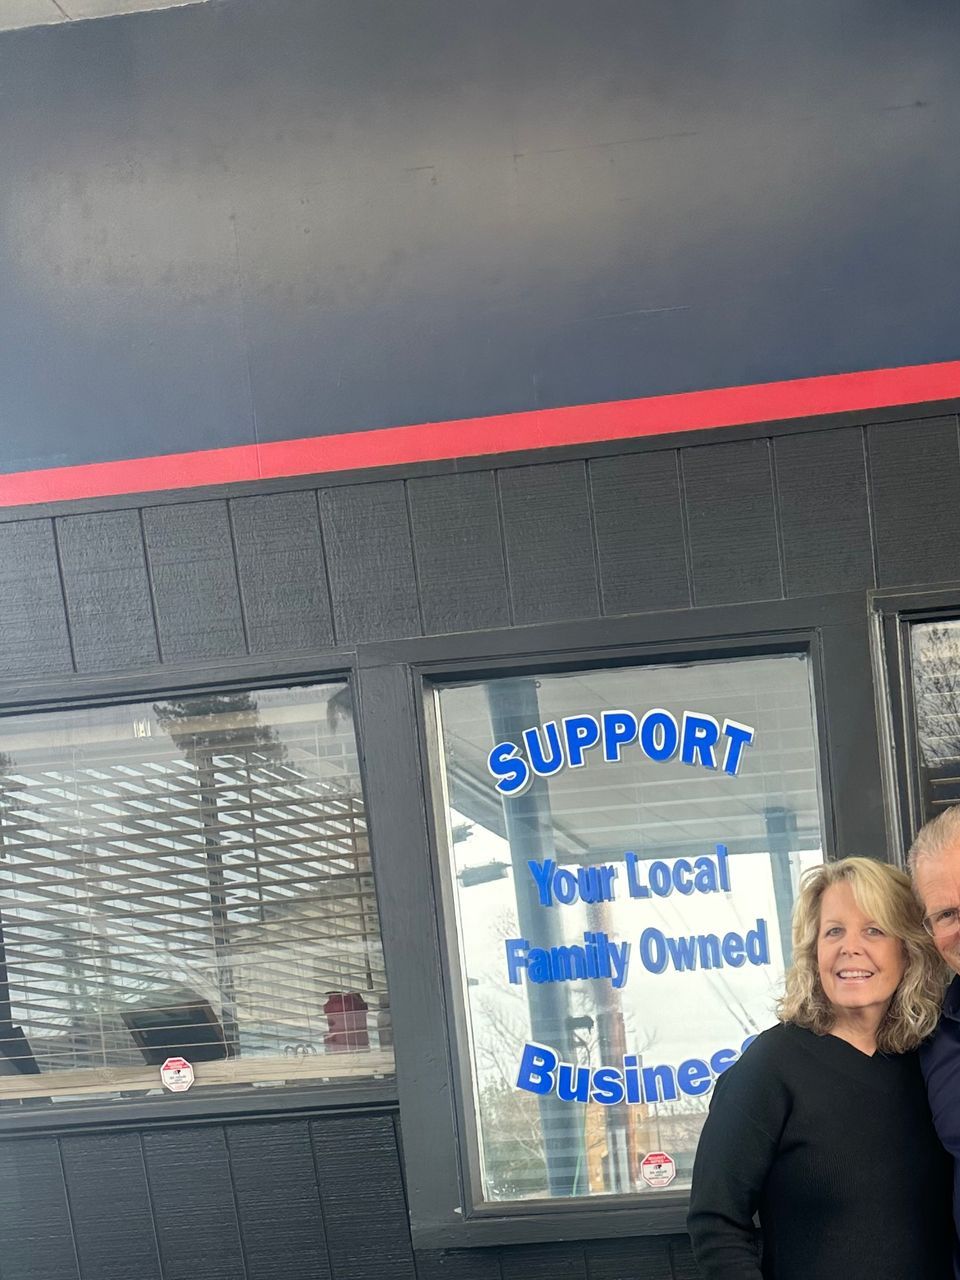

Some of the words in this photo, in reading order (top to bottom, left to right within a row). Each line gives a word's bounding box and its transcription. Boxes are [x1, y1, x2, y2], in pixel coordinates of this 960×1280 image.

[488, 708, 755, 795] SUPPORT
[528, 858, 618, 907] Your
[624, 844, 731, 899] Local
[505, 931, 631, 988] Family
[639, 918, 771, 974] Owned
[515, 1033, 760, 1105] Busines
